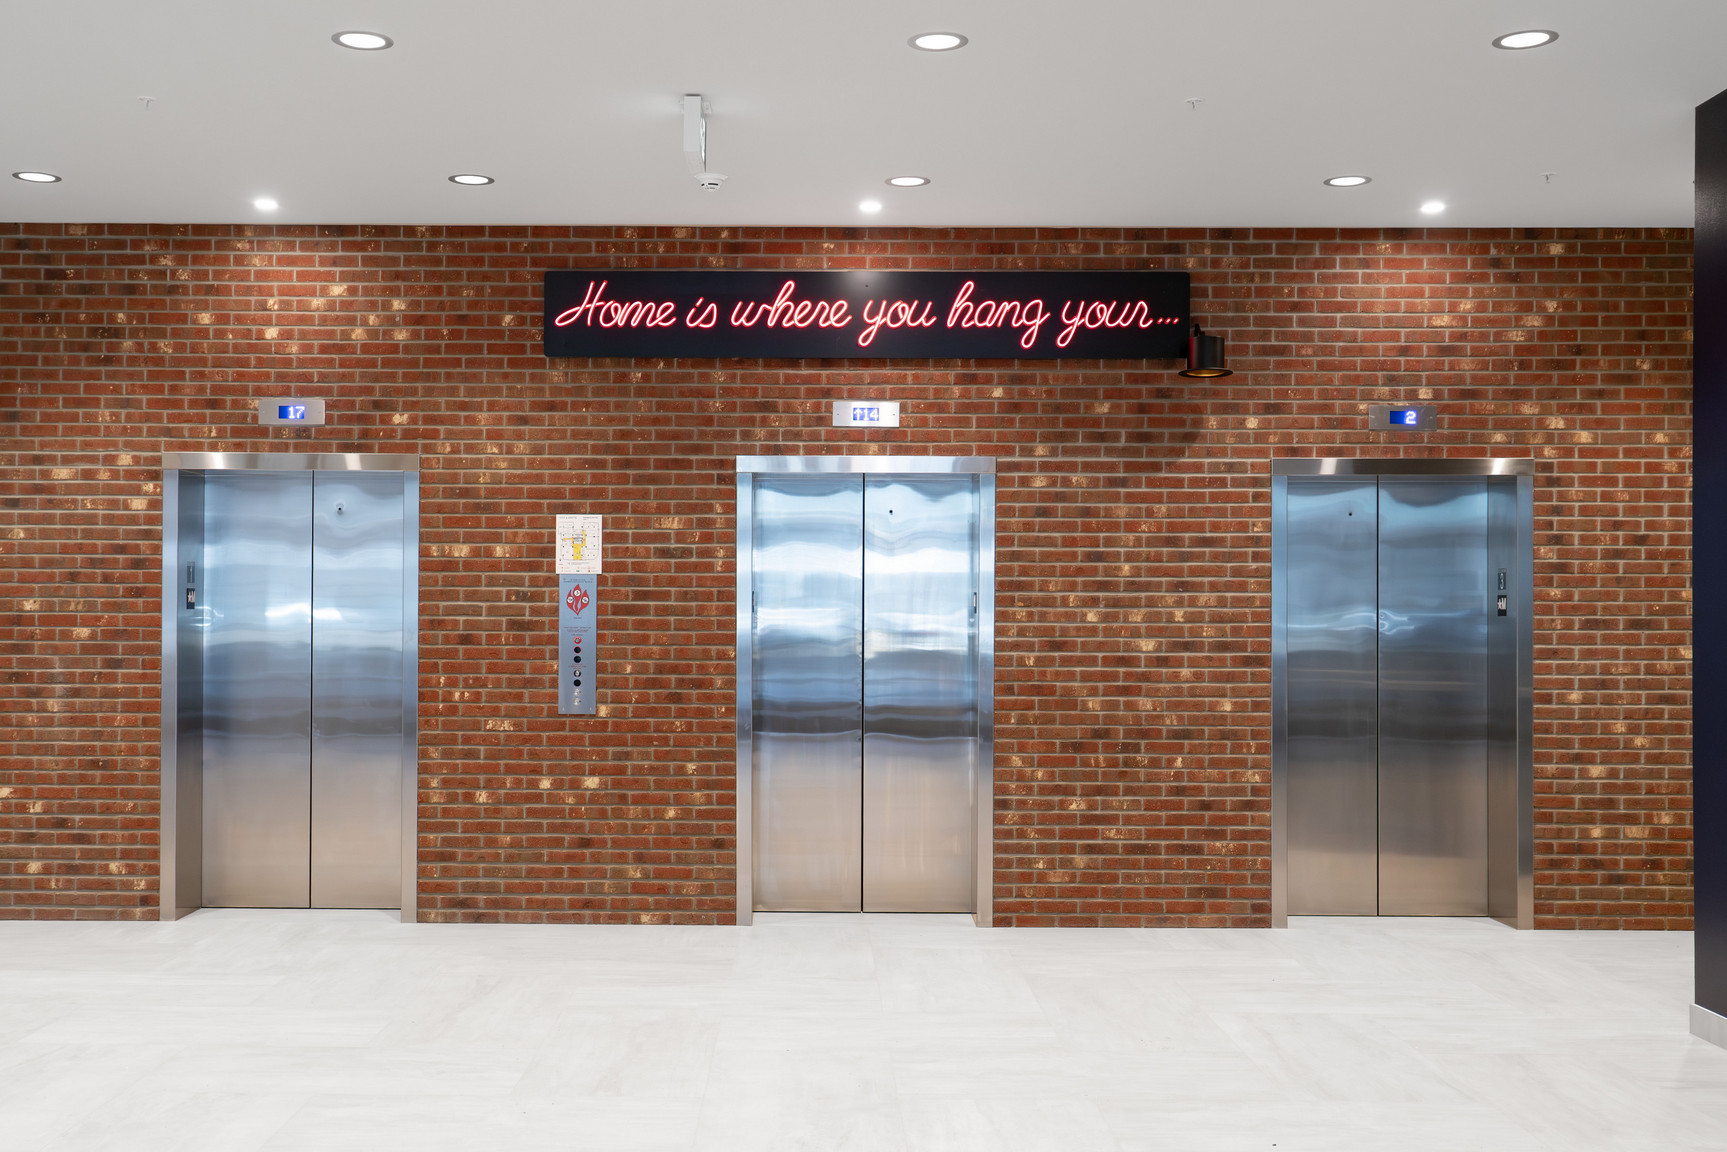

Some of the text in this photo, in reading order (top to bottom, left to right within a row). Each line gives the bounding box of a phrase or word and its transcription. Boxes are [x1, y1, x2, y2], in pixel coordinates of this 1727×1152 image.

[555, 280, 1180, 349] Home is where you hang your...
[288, 406, 305, 419] 17
[863, 408, 879, 421] 14
[1405, 410, 1417, 425] 2
